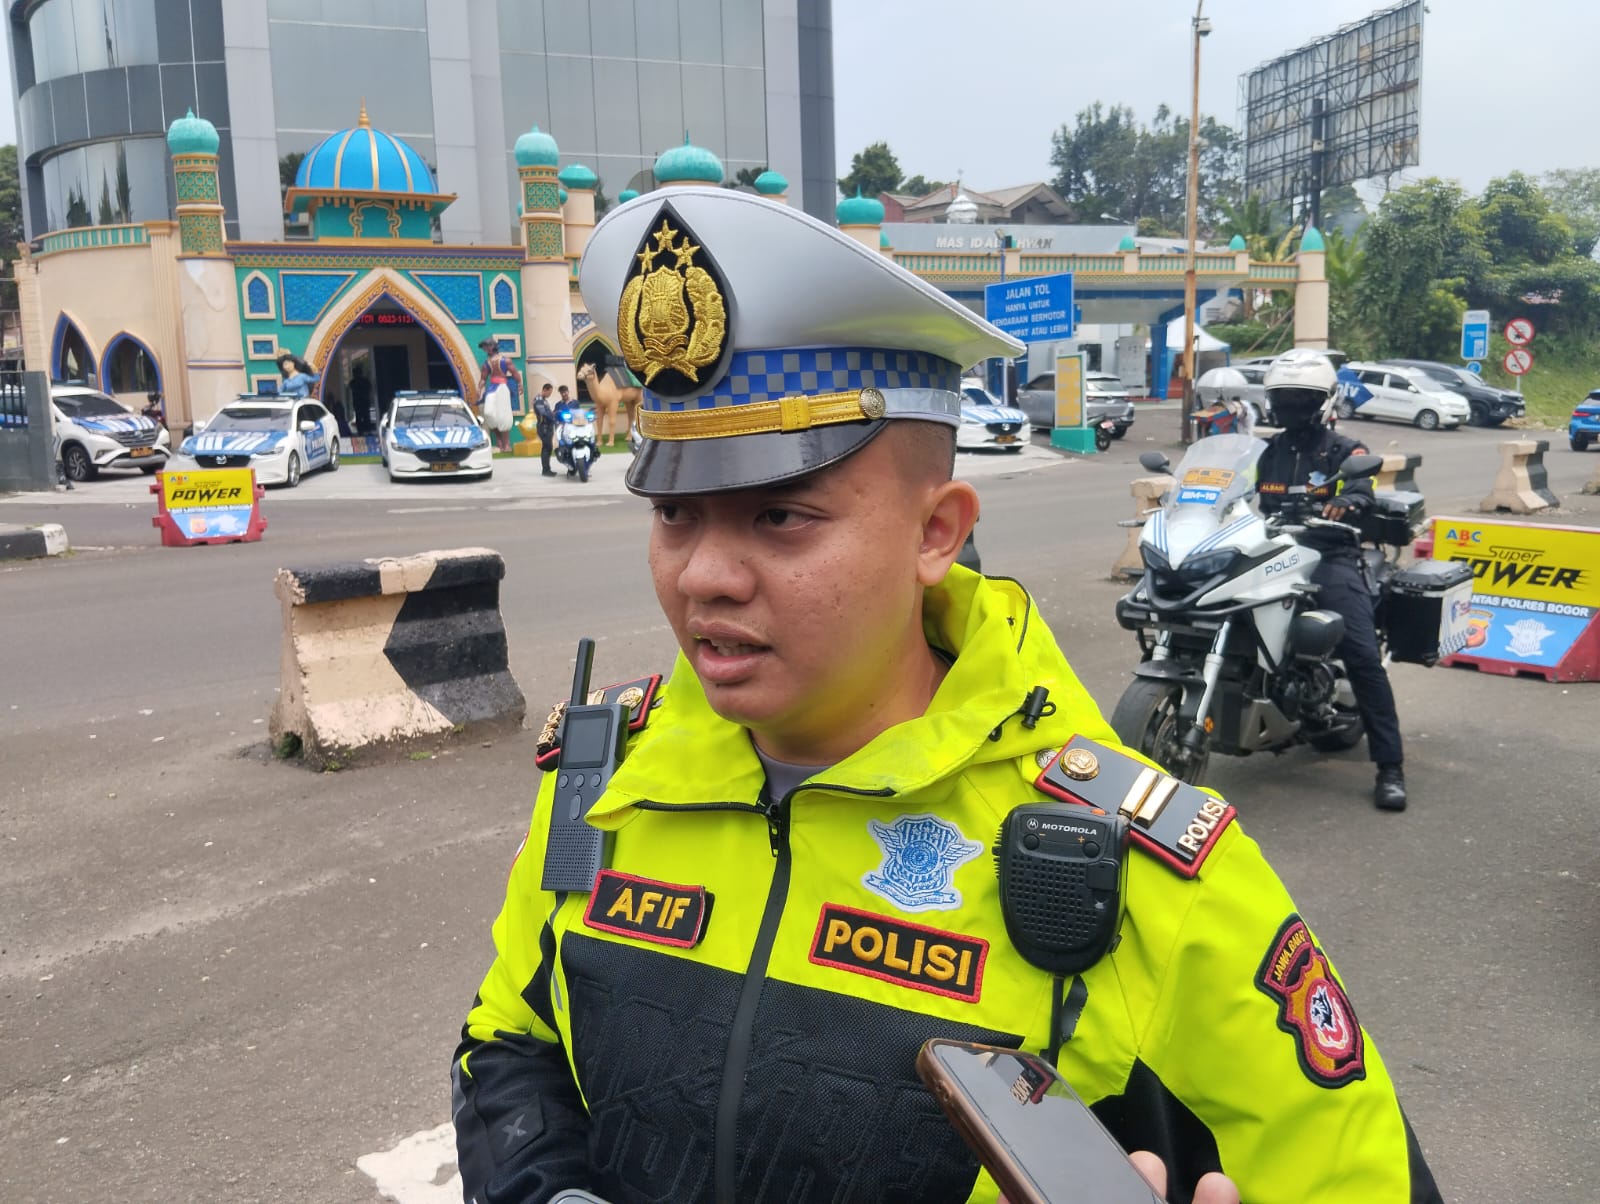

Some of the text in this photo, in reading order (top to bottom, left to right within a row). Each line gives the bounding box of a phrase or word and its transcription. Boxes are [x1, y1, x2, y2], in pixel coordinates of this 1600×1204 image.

[1016, 237, 1053, 248] HWAN
[1006, 284, 1051, 300] JALAN TOL
[1005, 299, 1050, 313] HANYA UNTUK
[1031, 311, 1066, 323] BERMOTOR
[1031, 326, 1048, 336] ATAU
[1050, 324, 1069, 334] LEBIH
[171, 488, 242, 502] POWER
[1446, 528, 1482, 543] ABC
[1489, 545, 1545, 563] Super
[1265, 553, 1301, 577] POLISI
[1448, 555, 1584, 589] OWER
[1471, 594, 1590, 617] NTAS POLRES BOGOR
[1041, 822, 1098, 835] MOTOROLA
[1177, 796, 1230, 854] POLISI
[606, 887, 692, 930] AFIF
[823, 918, 973, 986] POLISI
